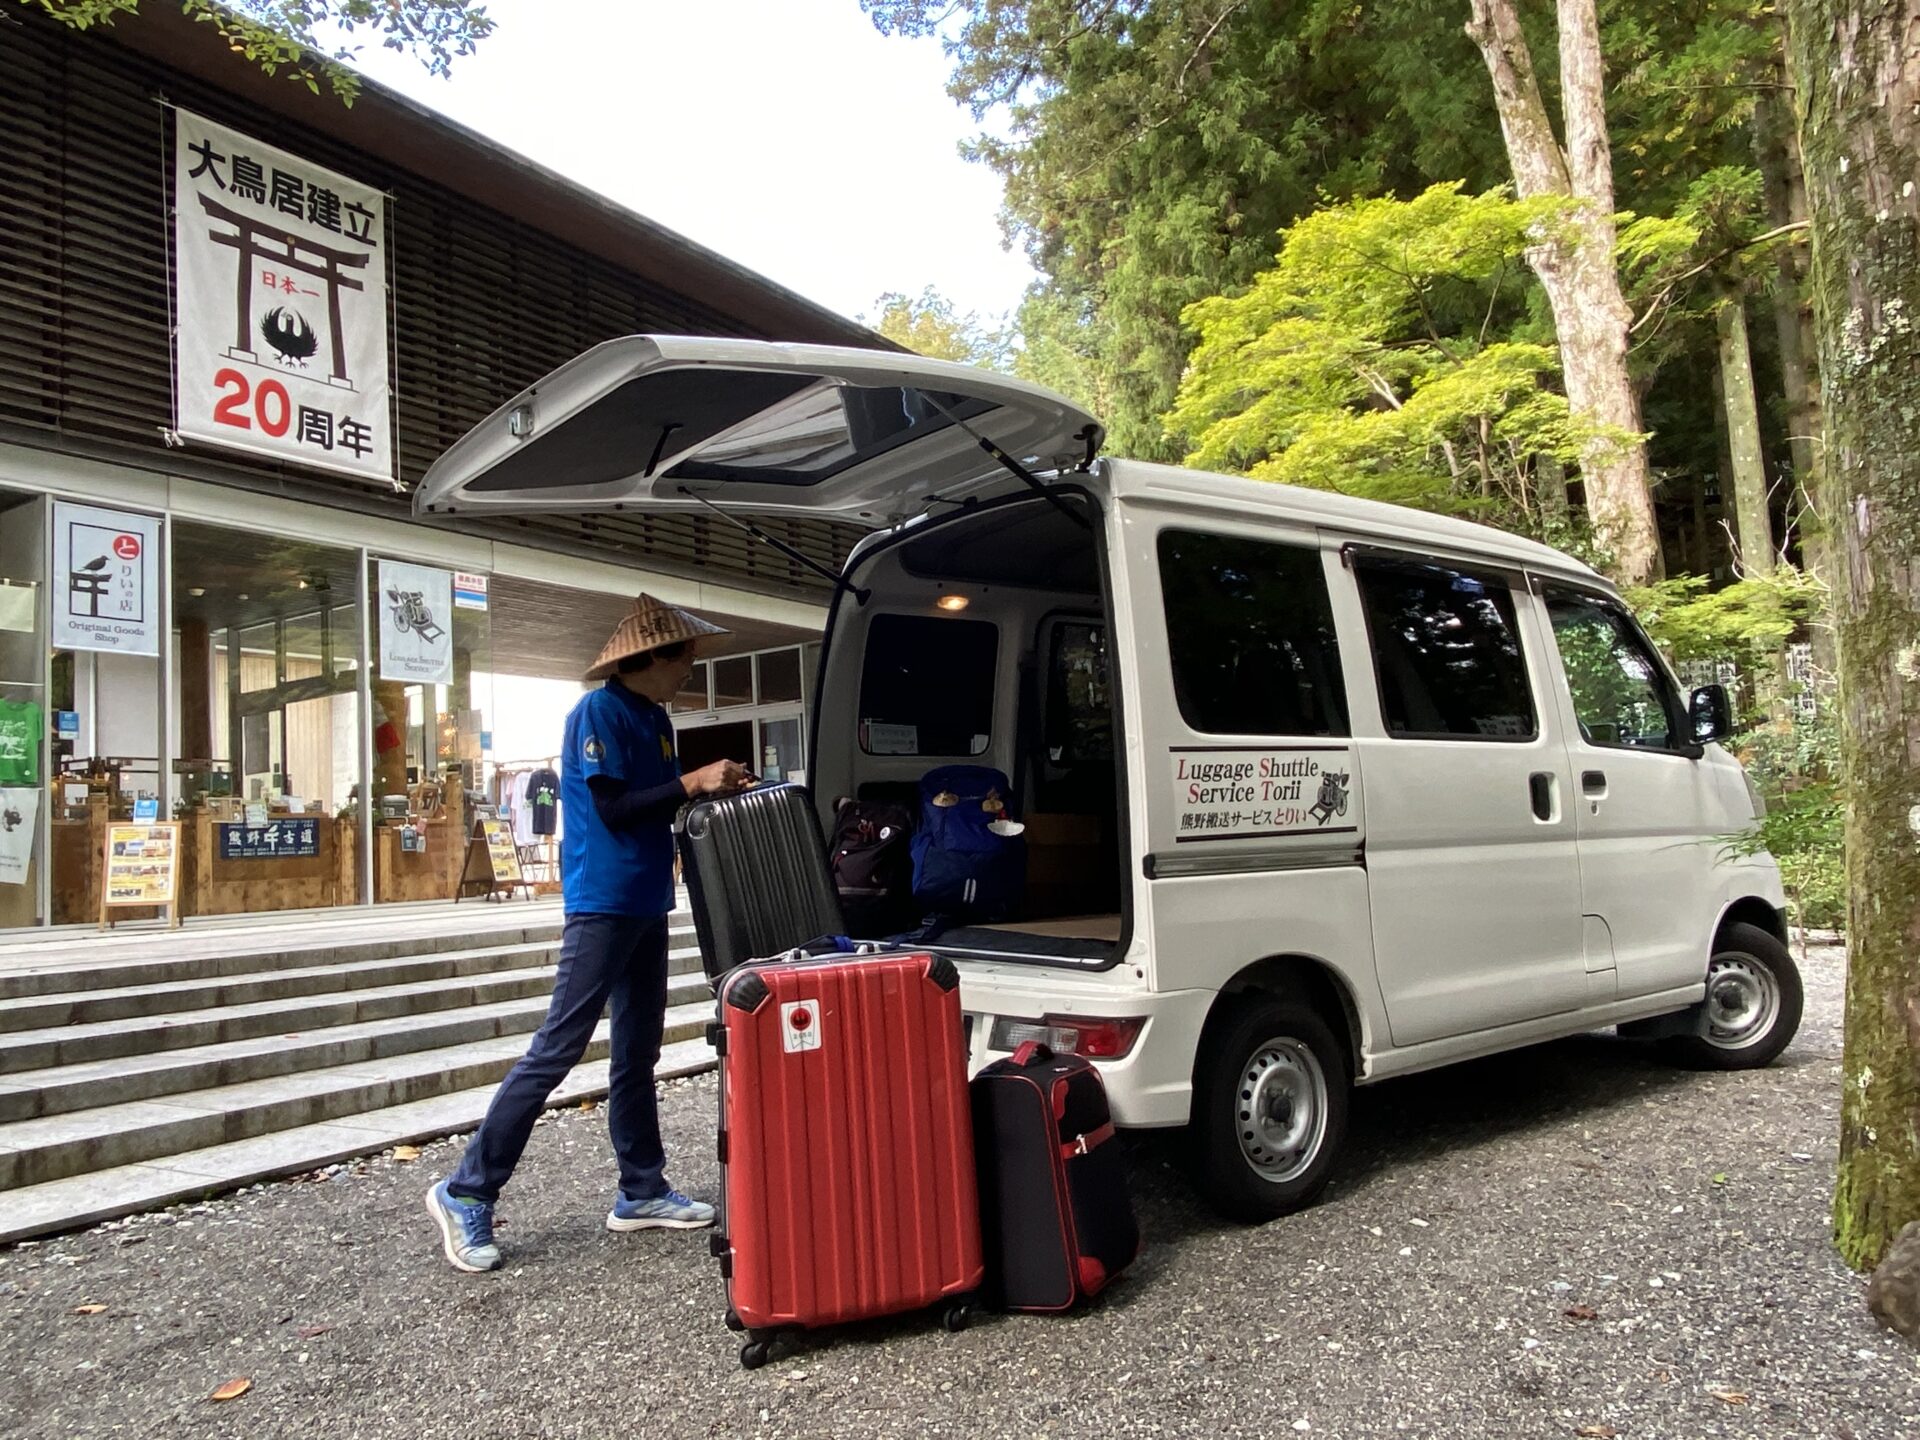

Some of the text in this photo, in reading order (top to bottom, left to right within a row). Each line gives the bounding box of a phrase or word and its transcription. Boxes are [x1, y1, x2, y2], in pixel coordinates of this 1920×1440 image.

[188, 138, 377, 248] 大鳥居建立
[262, 270, 320, 297] 日本一
[213, 368, 373, 459] 20周年
[68, 620, 145, 636] Original Goods
[94, 632, 119, 644] Shop
[1176, 757, 1319, 783] Luggage Shuttle
[1187, 780, 1302, 804] Service Torii
[1180, 807, 1307, 830] 熊野搬送サービスとりい
